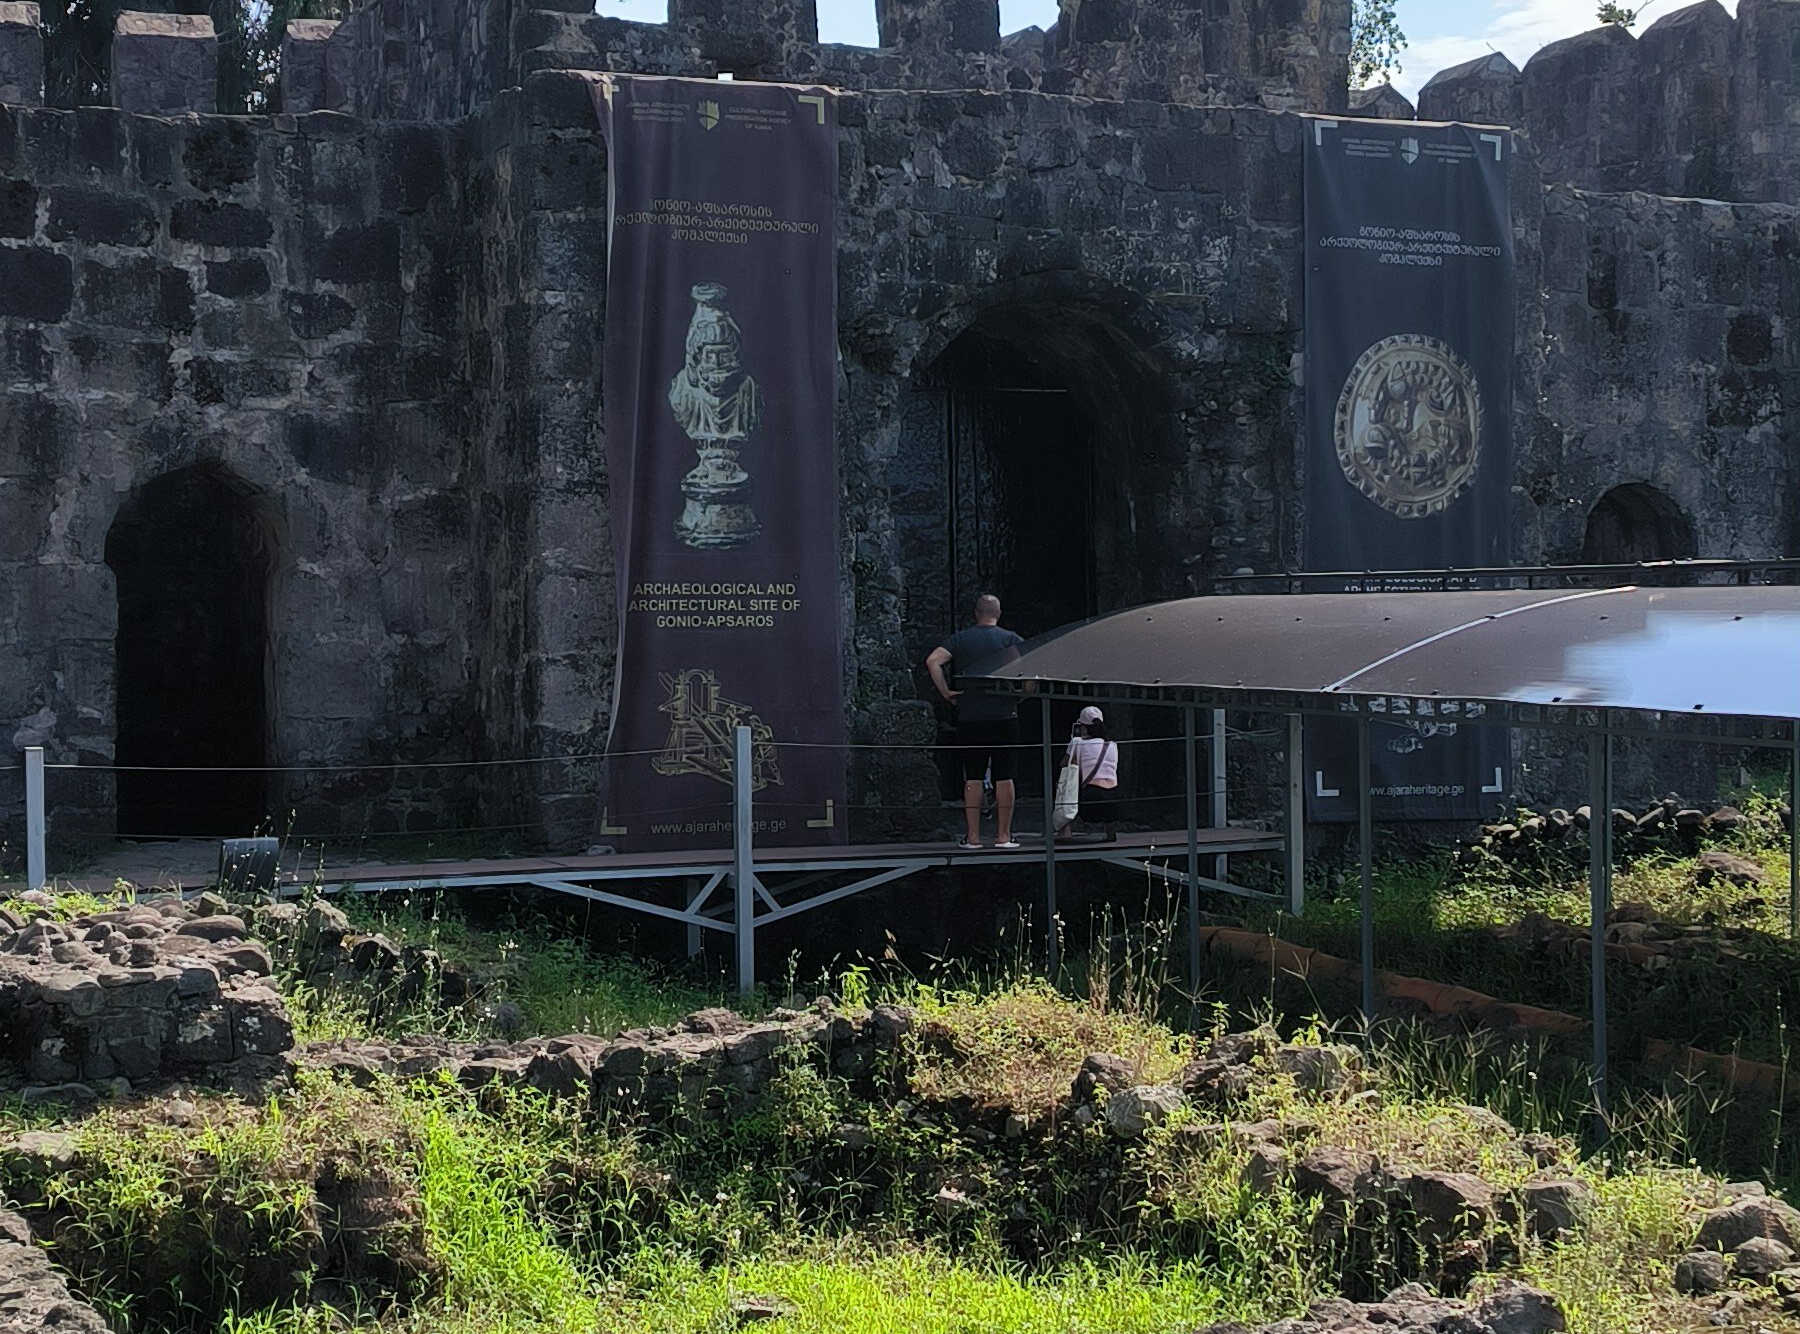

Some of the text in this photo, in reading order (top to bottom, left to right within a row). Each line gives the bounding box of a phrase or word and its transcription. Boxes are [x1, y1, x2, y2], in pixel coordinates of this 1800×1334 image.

[615, 212, 819, 234] რქეოლოგიურ-არქიტექტურული
[671, 229, 748, 244] კომპლექსი
[633, 583, 796, 595] ARCHAEOLOGICAL AND
[628, 599, 801, 612] ARCHITECTURAL SITE OF
[656, 616, 774, 628] GONIO-APSAROS
